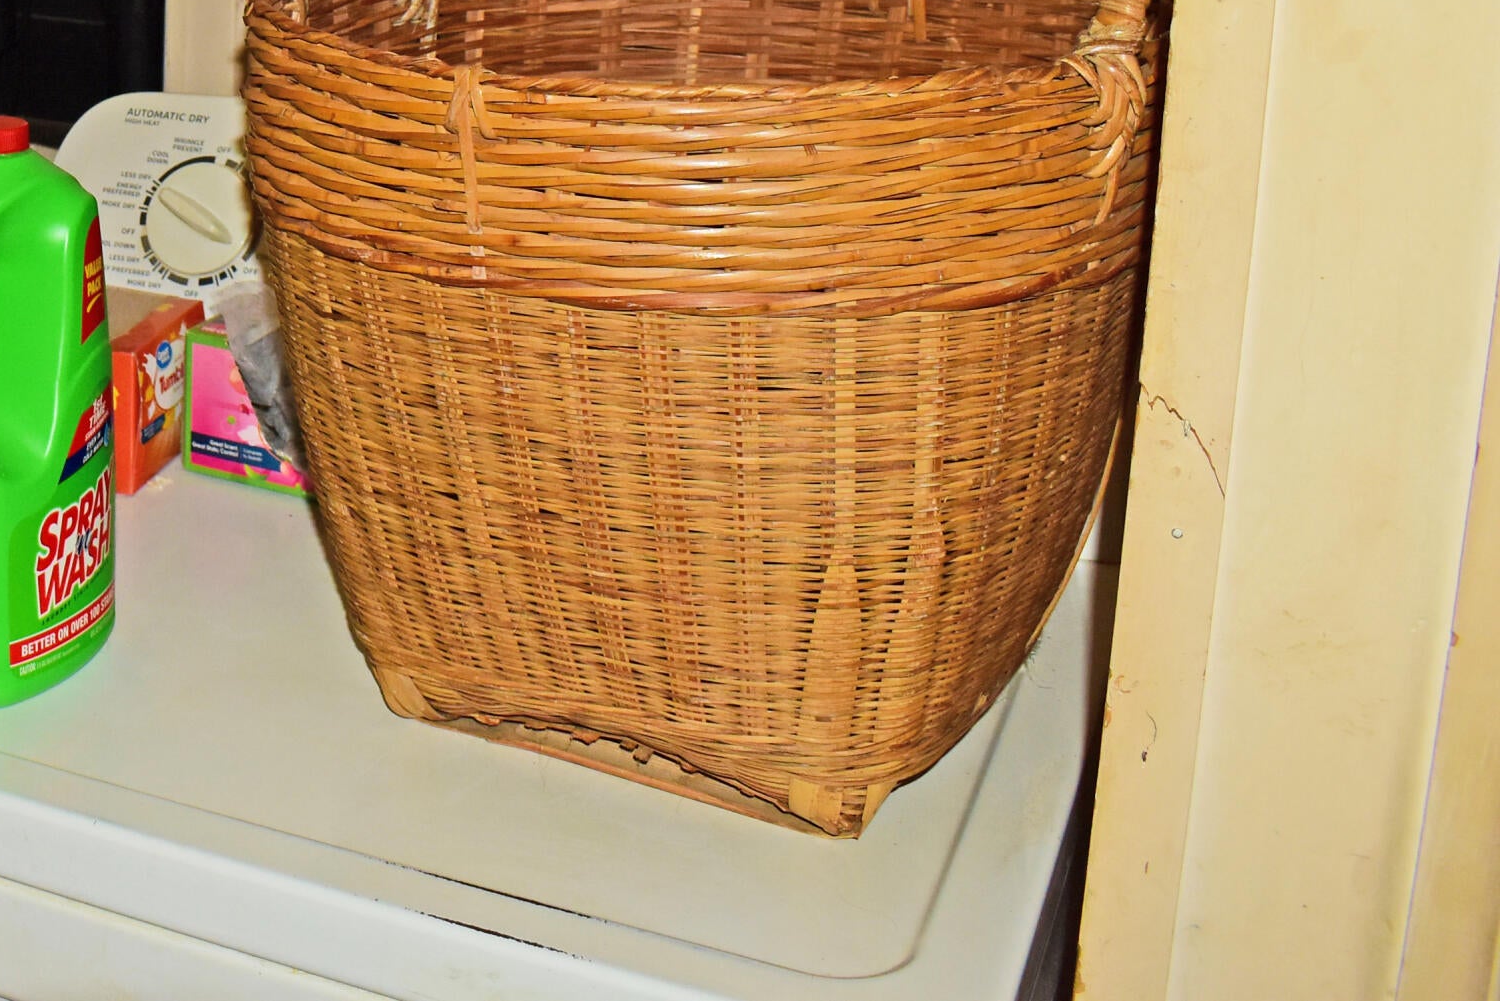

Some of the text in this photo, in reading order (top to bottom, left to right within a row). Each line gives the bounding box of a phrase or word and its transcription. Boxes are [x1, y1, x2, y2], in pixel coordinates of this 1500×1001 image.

[127, 108, 210, 124] AUTOMATIC DRY
[143, 119, 160, 127] HEAT
[174, 137, 205, 146] WRINKLE
[172, 145, 203, 153] PREVENT
[151, 150, 169, 158] COOL
[147, 157, 169, 165] DOWN
[121, 171, 137, 179] LESS
[116, 182, 142, 190] ENERGY
[102, 187, 141, 197] PREFERRED
[101, 200, 121, 208] MORE
[109, 253, 140, 263] LESS DRY
[112, 266, 150, 277] PREFERRED
[127, 279, 146, 287] MORE
[36, 456, 114, 573] SPRAY
[37, 507, 111, 618] WASH
[21, 632, 56, 658] BETTER
[57, 625, 69, 641] ON
[70, 612, 89, 634] OVER
[90, 603, 101, 621] 100
